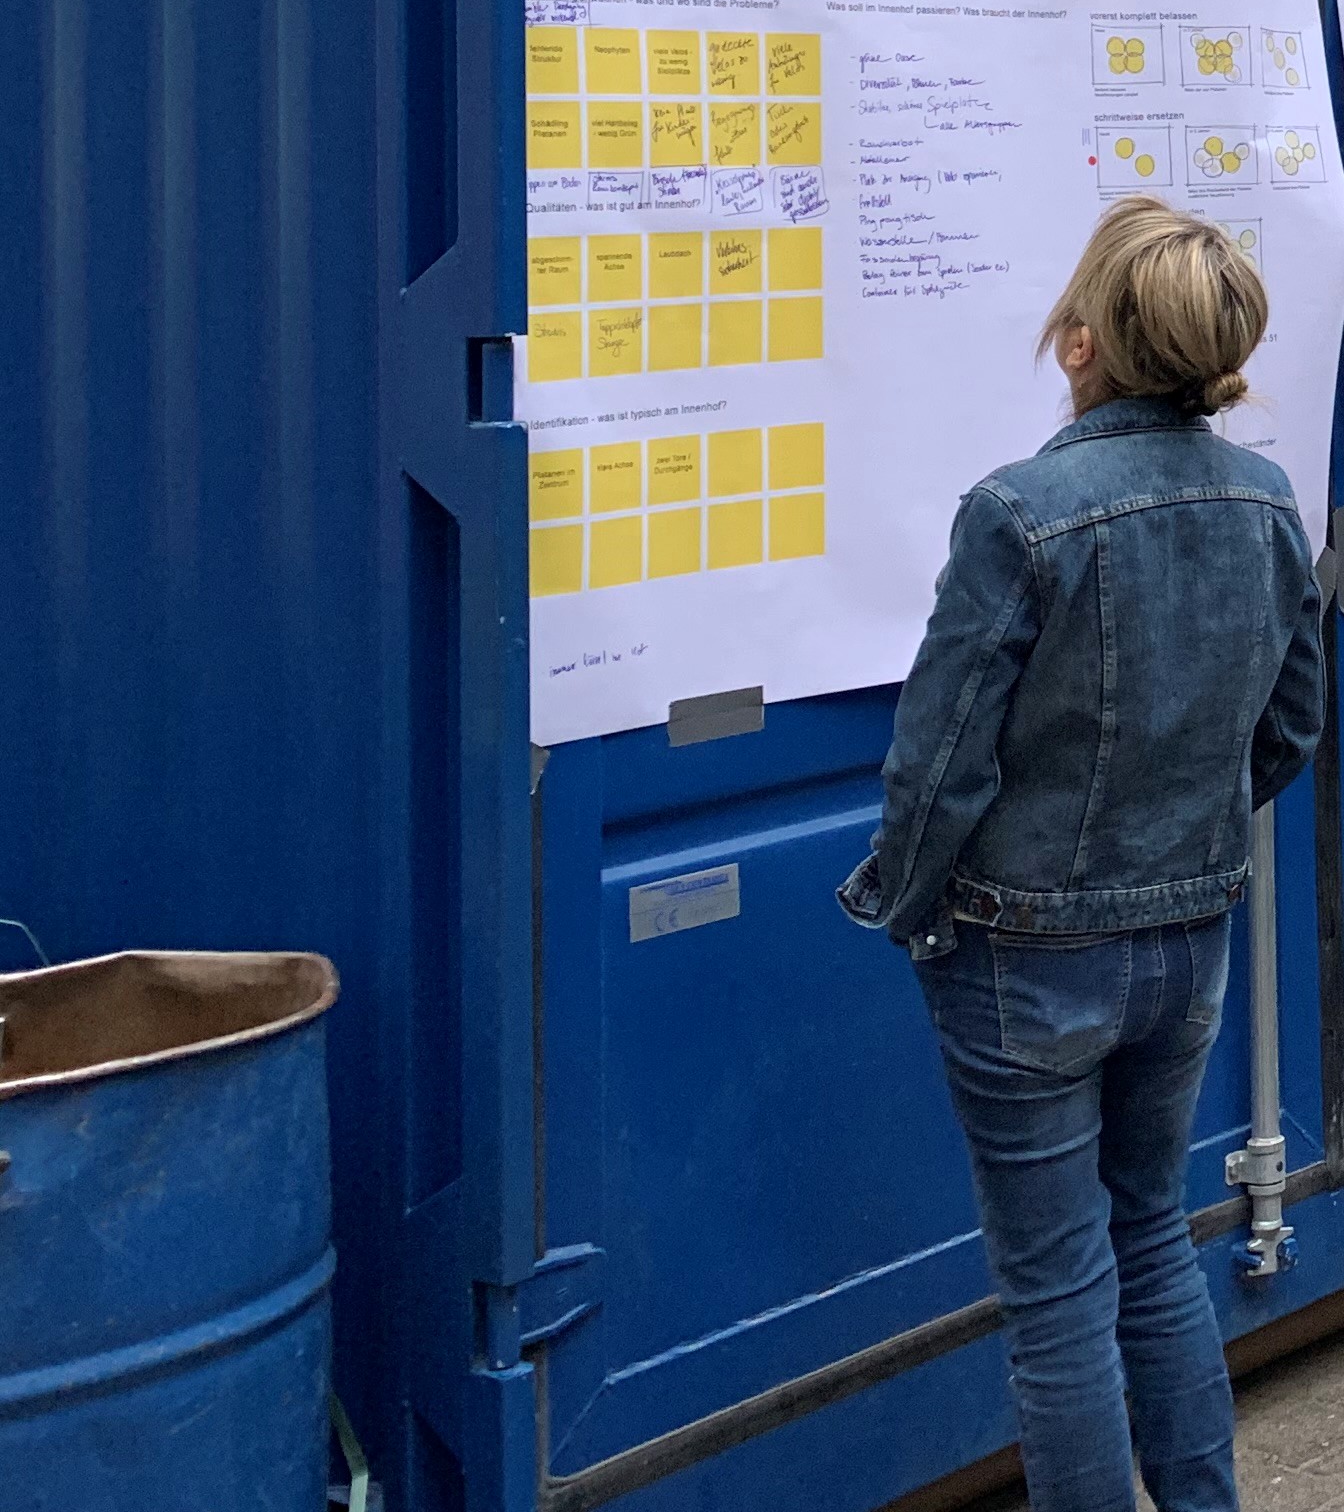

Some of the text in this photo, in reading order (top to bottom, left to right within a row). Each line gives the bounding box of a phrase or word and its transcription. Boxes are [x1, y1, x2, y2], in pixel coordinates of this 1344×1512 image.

[826, 1, 1067, 20] Was soll im Innenhof passieren? Was braucht der Innenhof?
[1090, 11, 1198, 23] vorerst komplett belassen
[1094, 110, 1185, 123] schrittweise ersetzen
[526, 201, 577, 214] Qualitäten
[585, 202, 604, 212] was
[607, 201, 618, 211] ist
[620, 200, 635, 213] gut
[636, 201, 653, 210] am
[655, 198, 701, 210] Innenhof?
[530, 414, 589, 431] Identifikation
[597, 414, 615, 423] was
[617, 410, 629, 421] ist
[630, 406, 663, 422] typisch
[664, 406, 678, 416] am
[681, 400, 728, 415] Innenhof?
